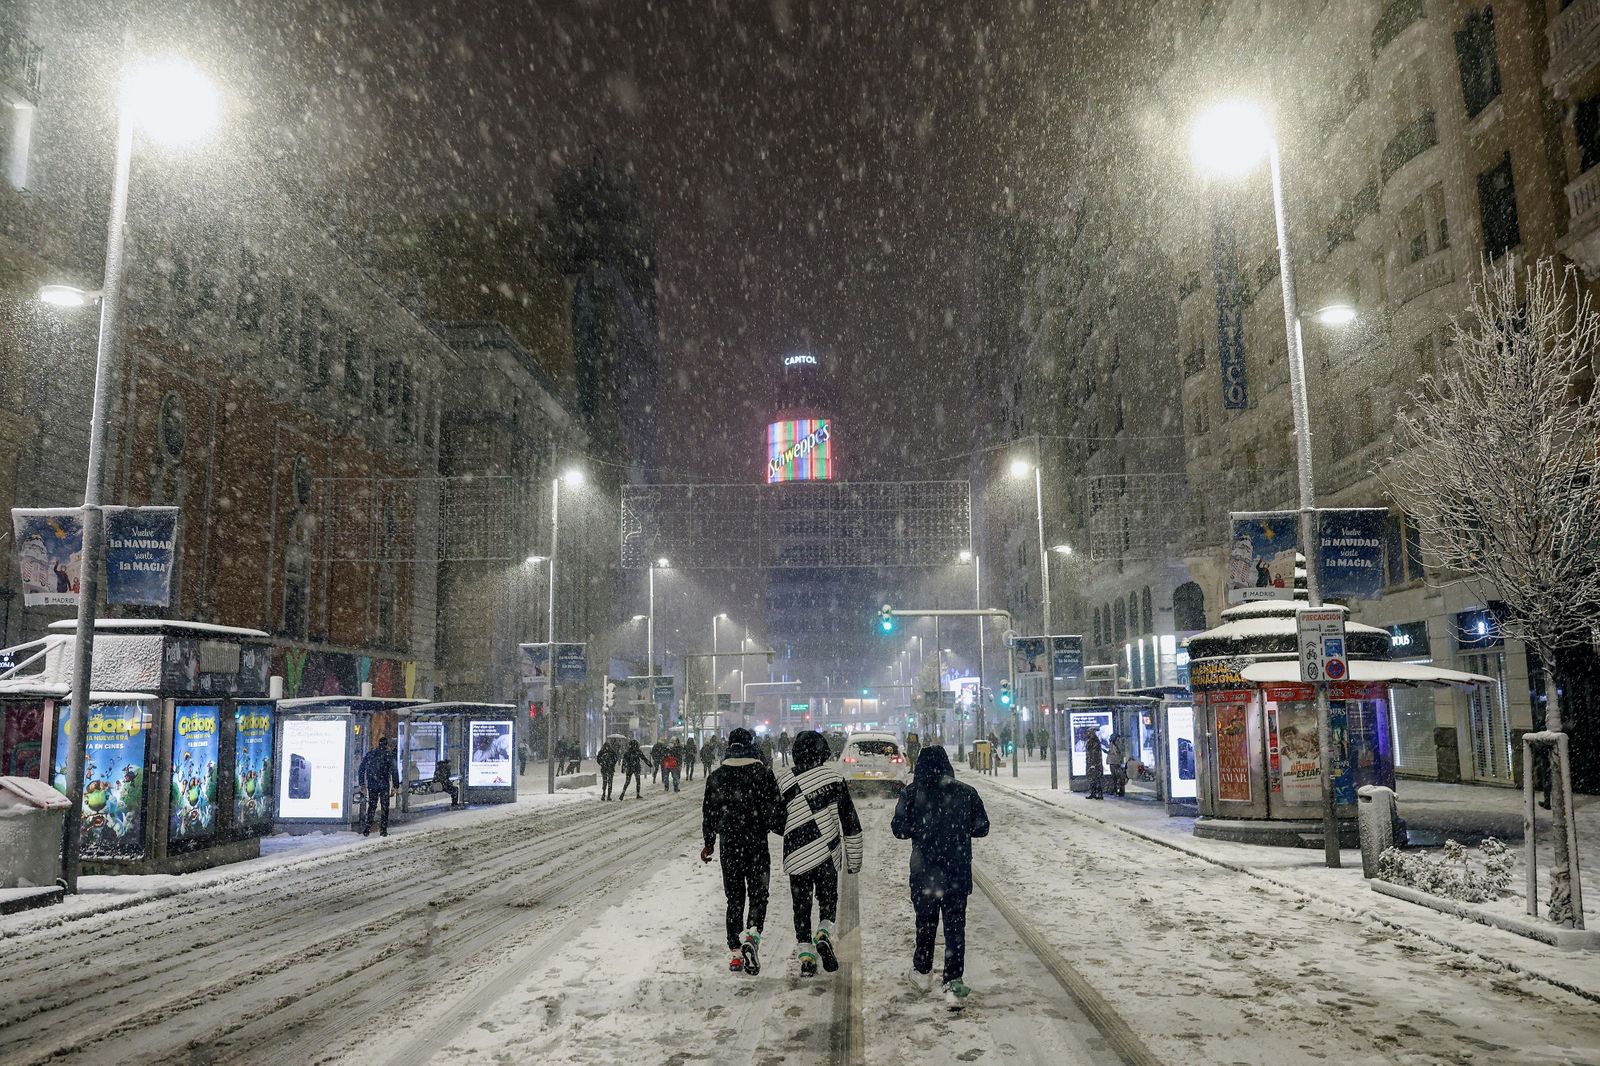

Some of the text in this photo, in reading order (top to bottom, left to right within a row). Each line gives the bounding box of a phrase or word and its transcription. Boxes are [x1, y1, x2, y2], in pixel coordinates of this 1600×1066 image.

[784, 355, 817, 366] CAPITOL
[768, 424, 830, 478] Schweppes
[110, 538, 174, 549] la NAVIDAD
[1321, 537, 1380, 547] la NAVIDAD
[119, 562, 165, 573] la MAGIA
[1326, 559, 1372, 568] la MAGIA
[1391, 635, 1409, 647] TOUS
[178, 715, 216, 735] CROODS
[238, 714, 271, 732] CROODS
[1221, 773, 1248, 782] AMAR
[1296, 768, 1321, 778] ESTAF
